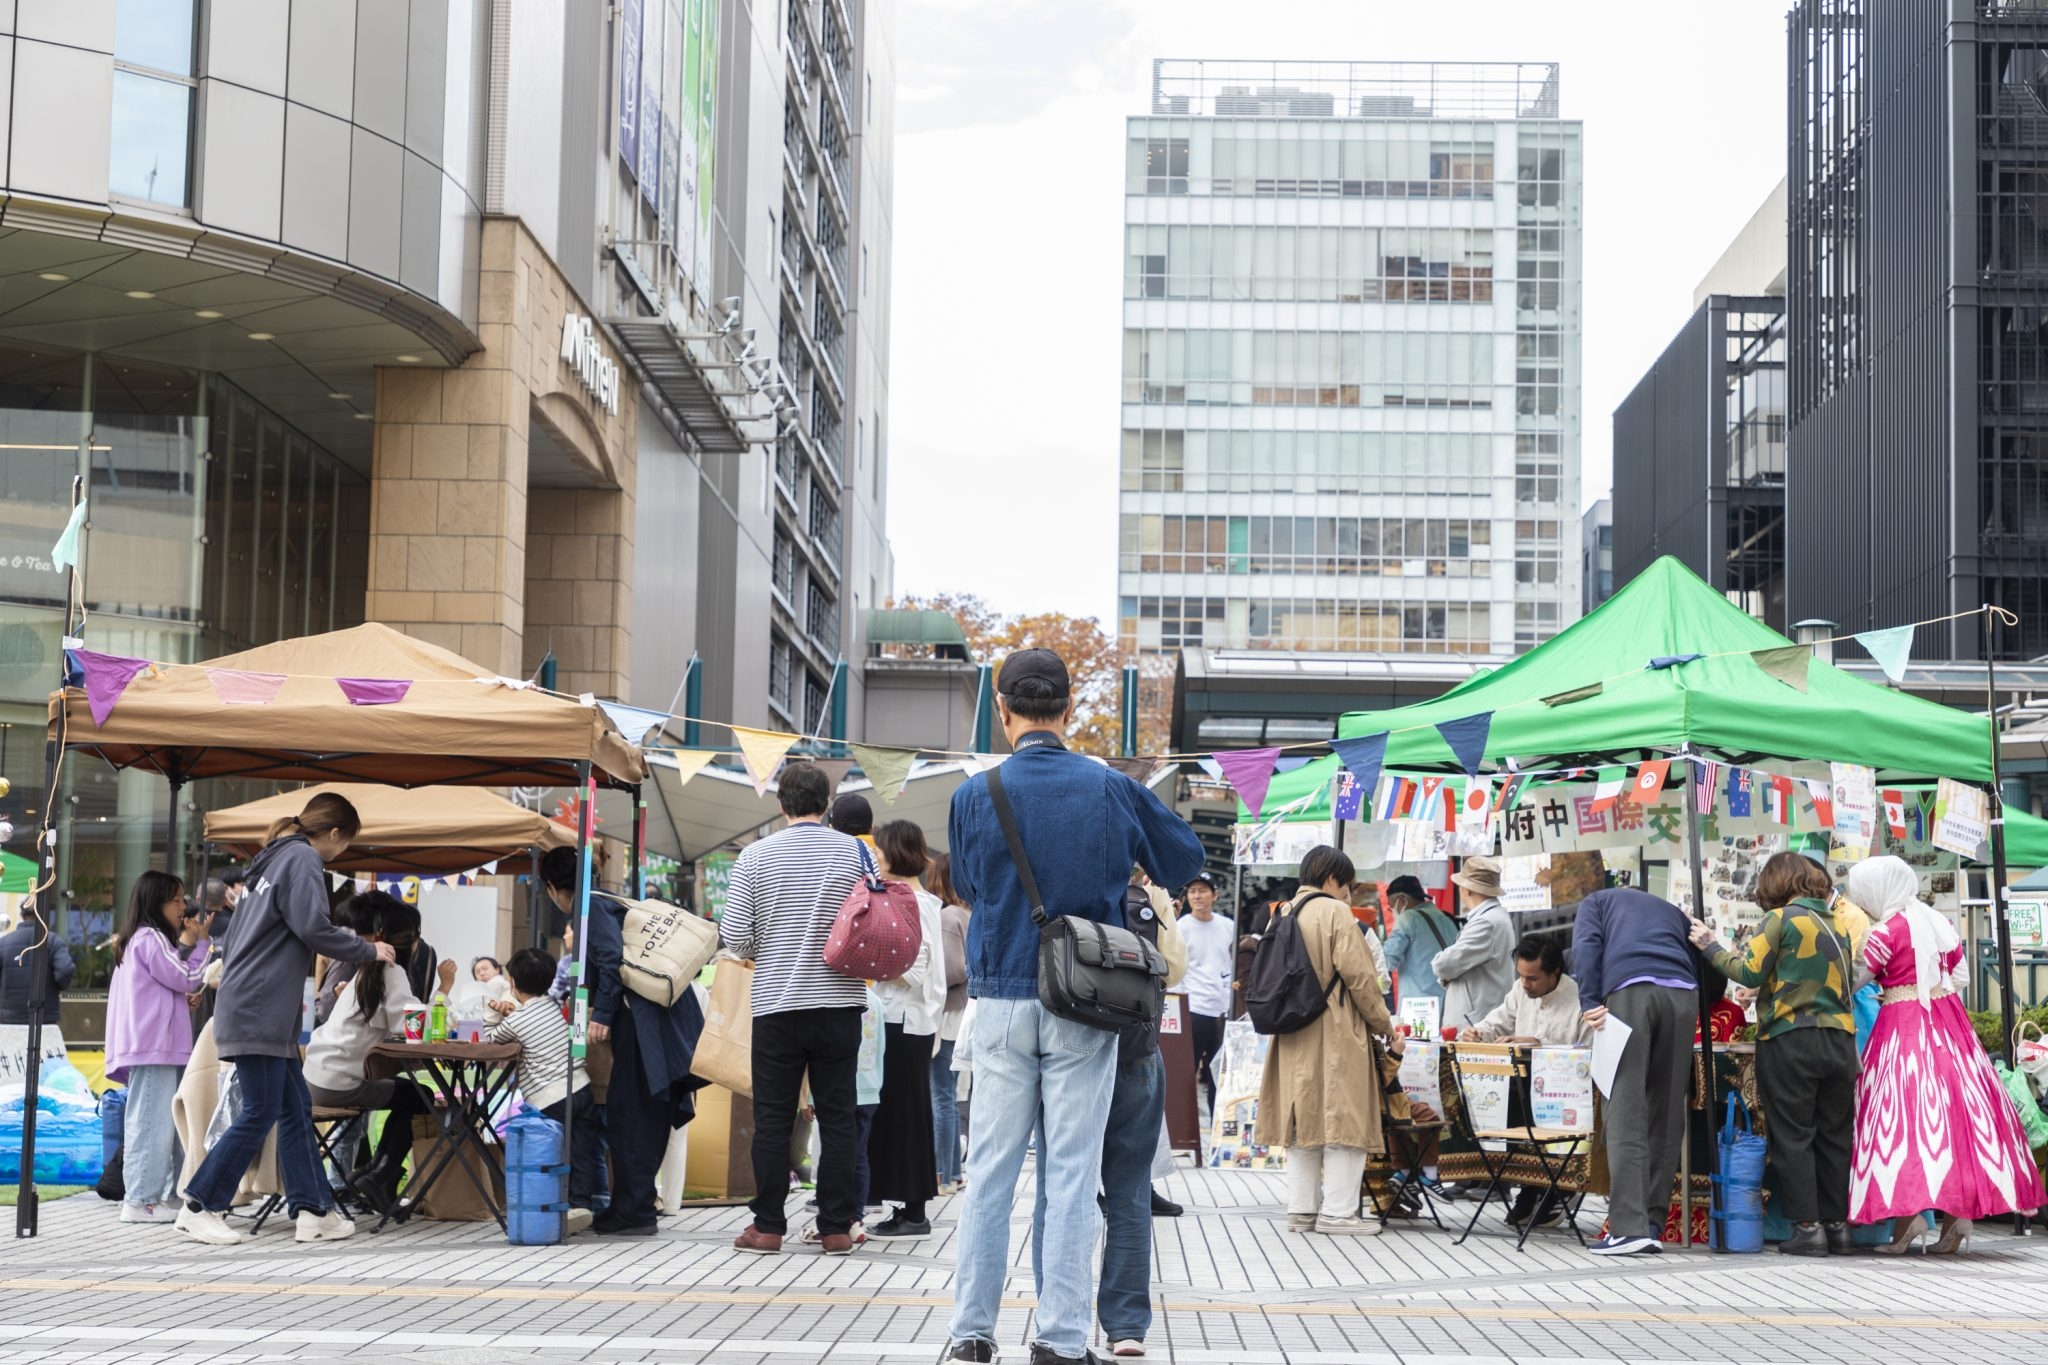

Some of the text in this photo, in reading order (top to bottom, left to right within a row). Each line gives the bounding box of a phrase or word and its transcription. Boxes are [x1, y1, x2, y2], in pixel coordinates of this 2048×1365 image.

[25, 555, 51, 571] Tea
[2008, 909, 2033, 919] FREE
[640, 914, 662, 934] THE
[640, 927, 667, 959] TOTE
